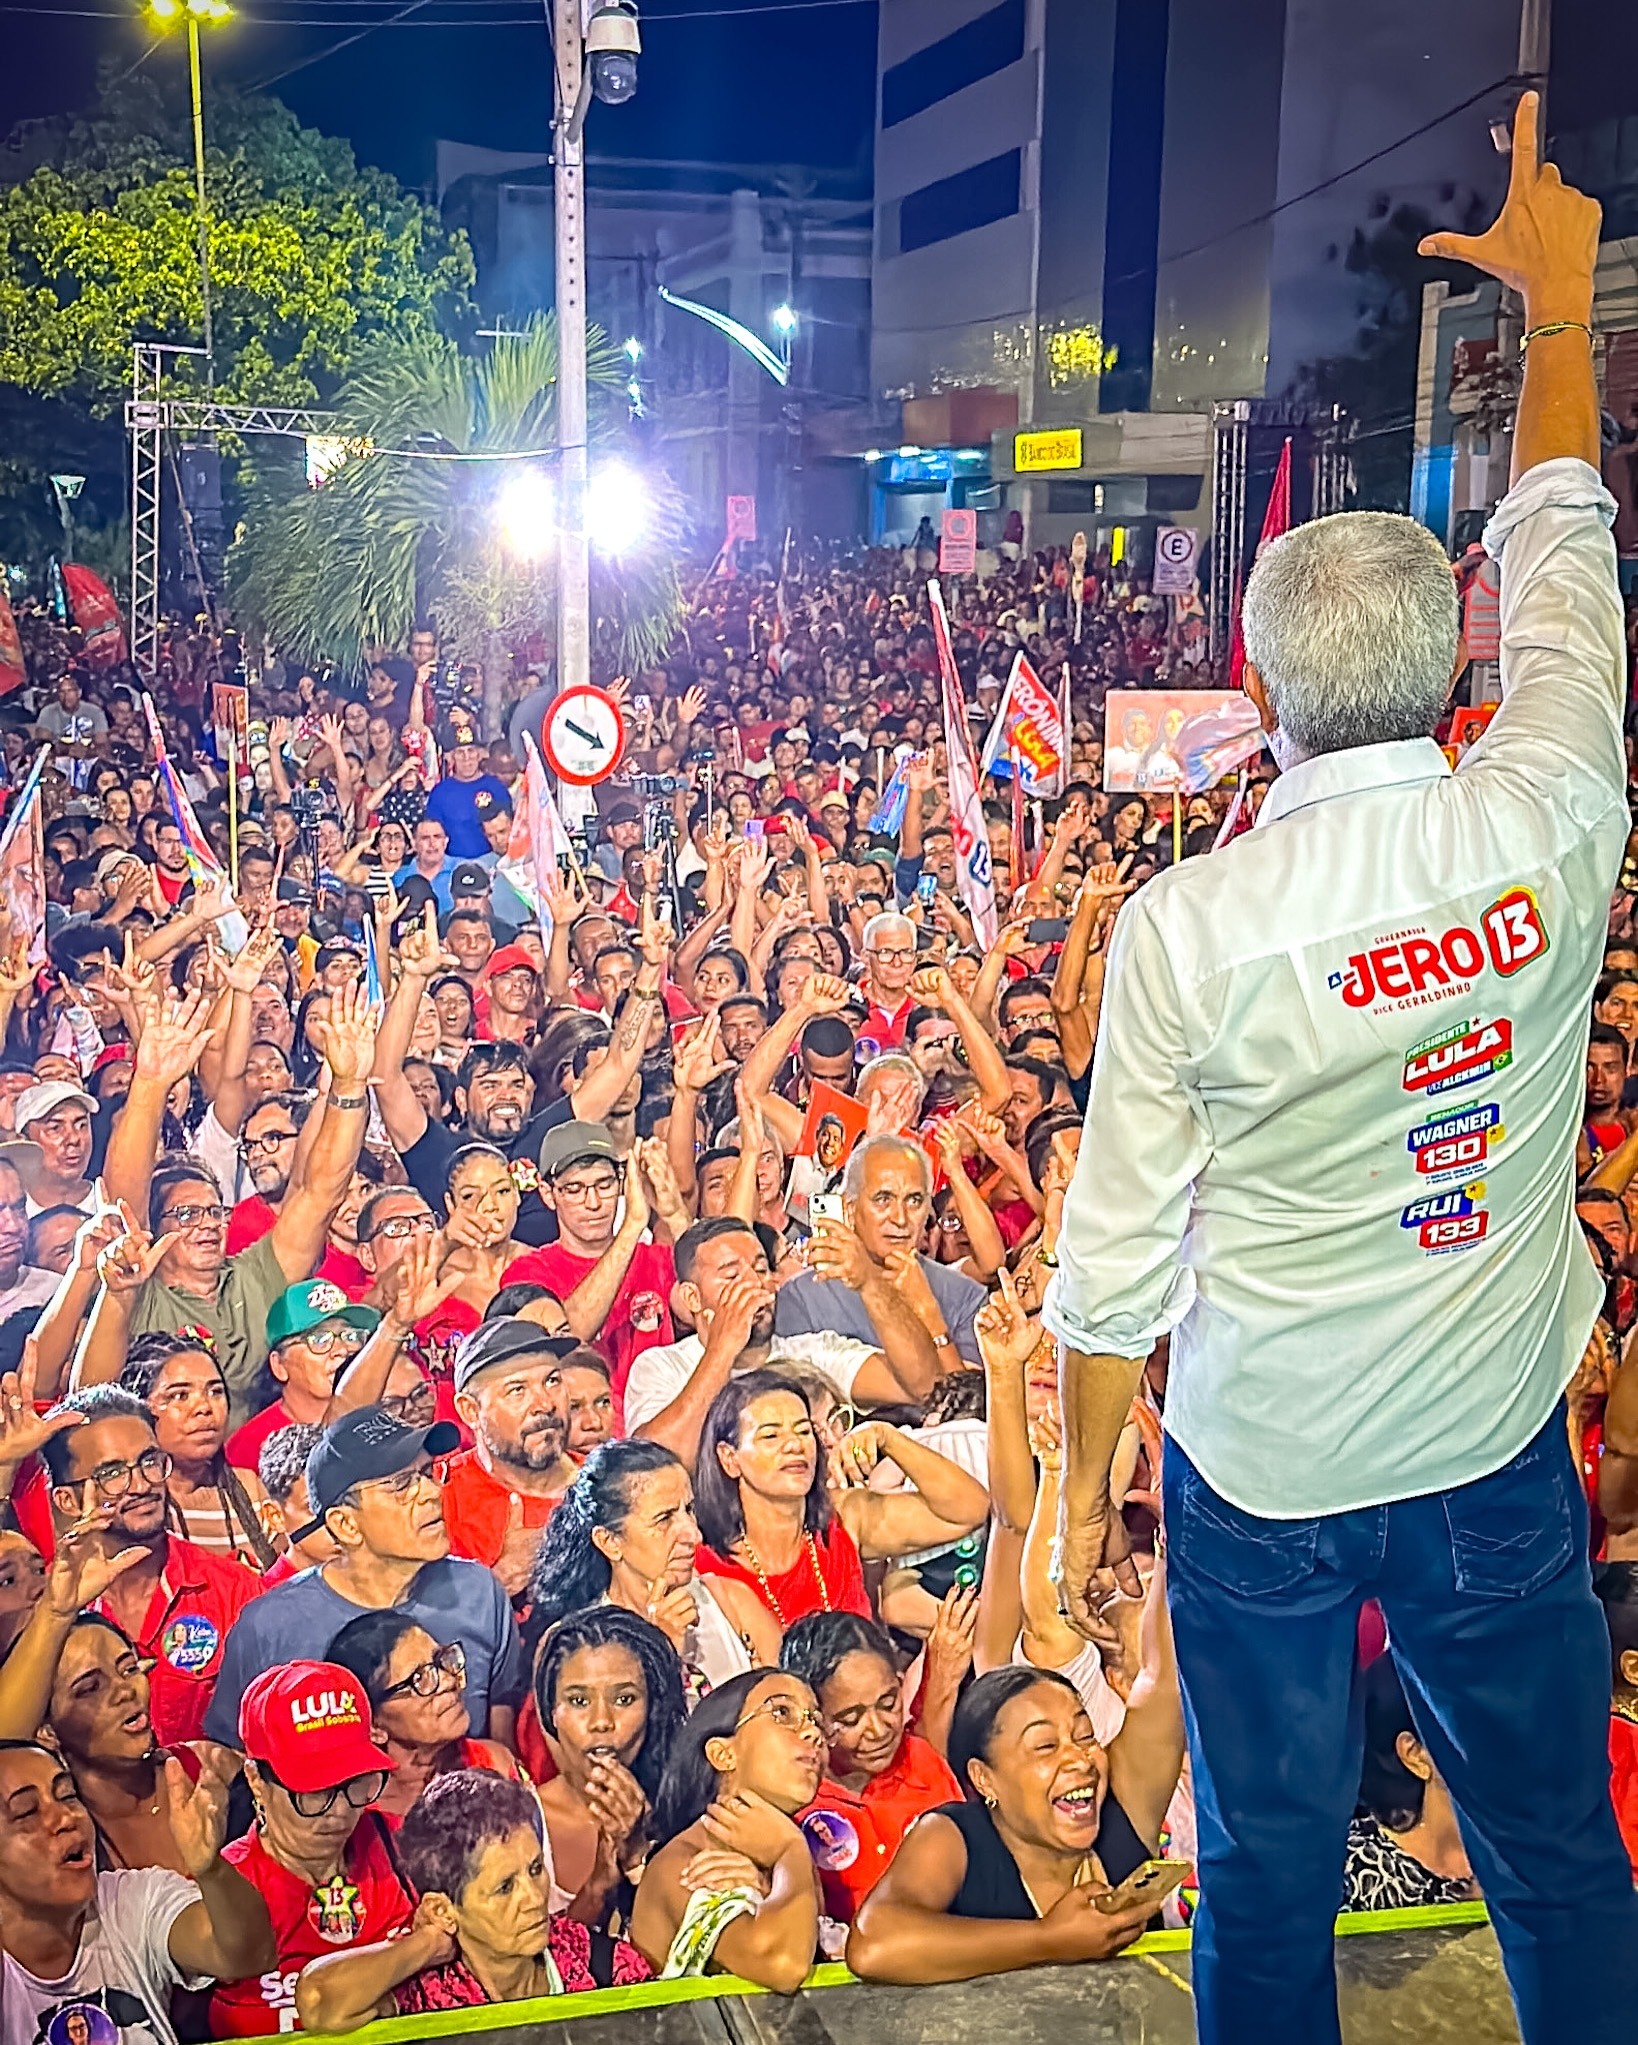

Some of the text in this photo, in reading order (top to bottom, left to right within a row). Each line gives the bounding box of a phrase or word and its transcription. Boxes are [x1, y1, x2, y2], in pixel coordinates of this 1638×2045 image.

[1171, 538, 1183, 556] E
[1342, 900, 1540, 1007] JERO 13
[1397, 982, 1471, 1010] GERALDINHO
[1405, 1026, 1503, 1082] LULA
[1406, 1022, 1466, 1060] PRESIDENTE
[1412, 1109, 1492, 1147] WAGNER
[1423, 1136, 1481, 1169] 130
[1407, 1194, 1461, 1221] RUI
[1427, 1215, 1480, 1244] 133
[291, 1690, 357, 1724] LULA
[296, 1717, 324, 1733] Brasil
[329, 1887, 344, 1905] 13
